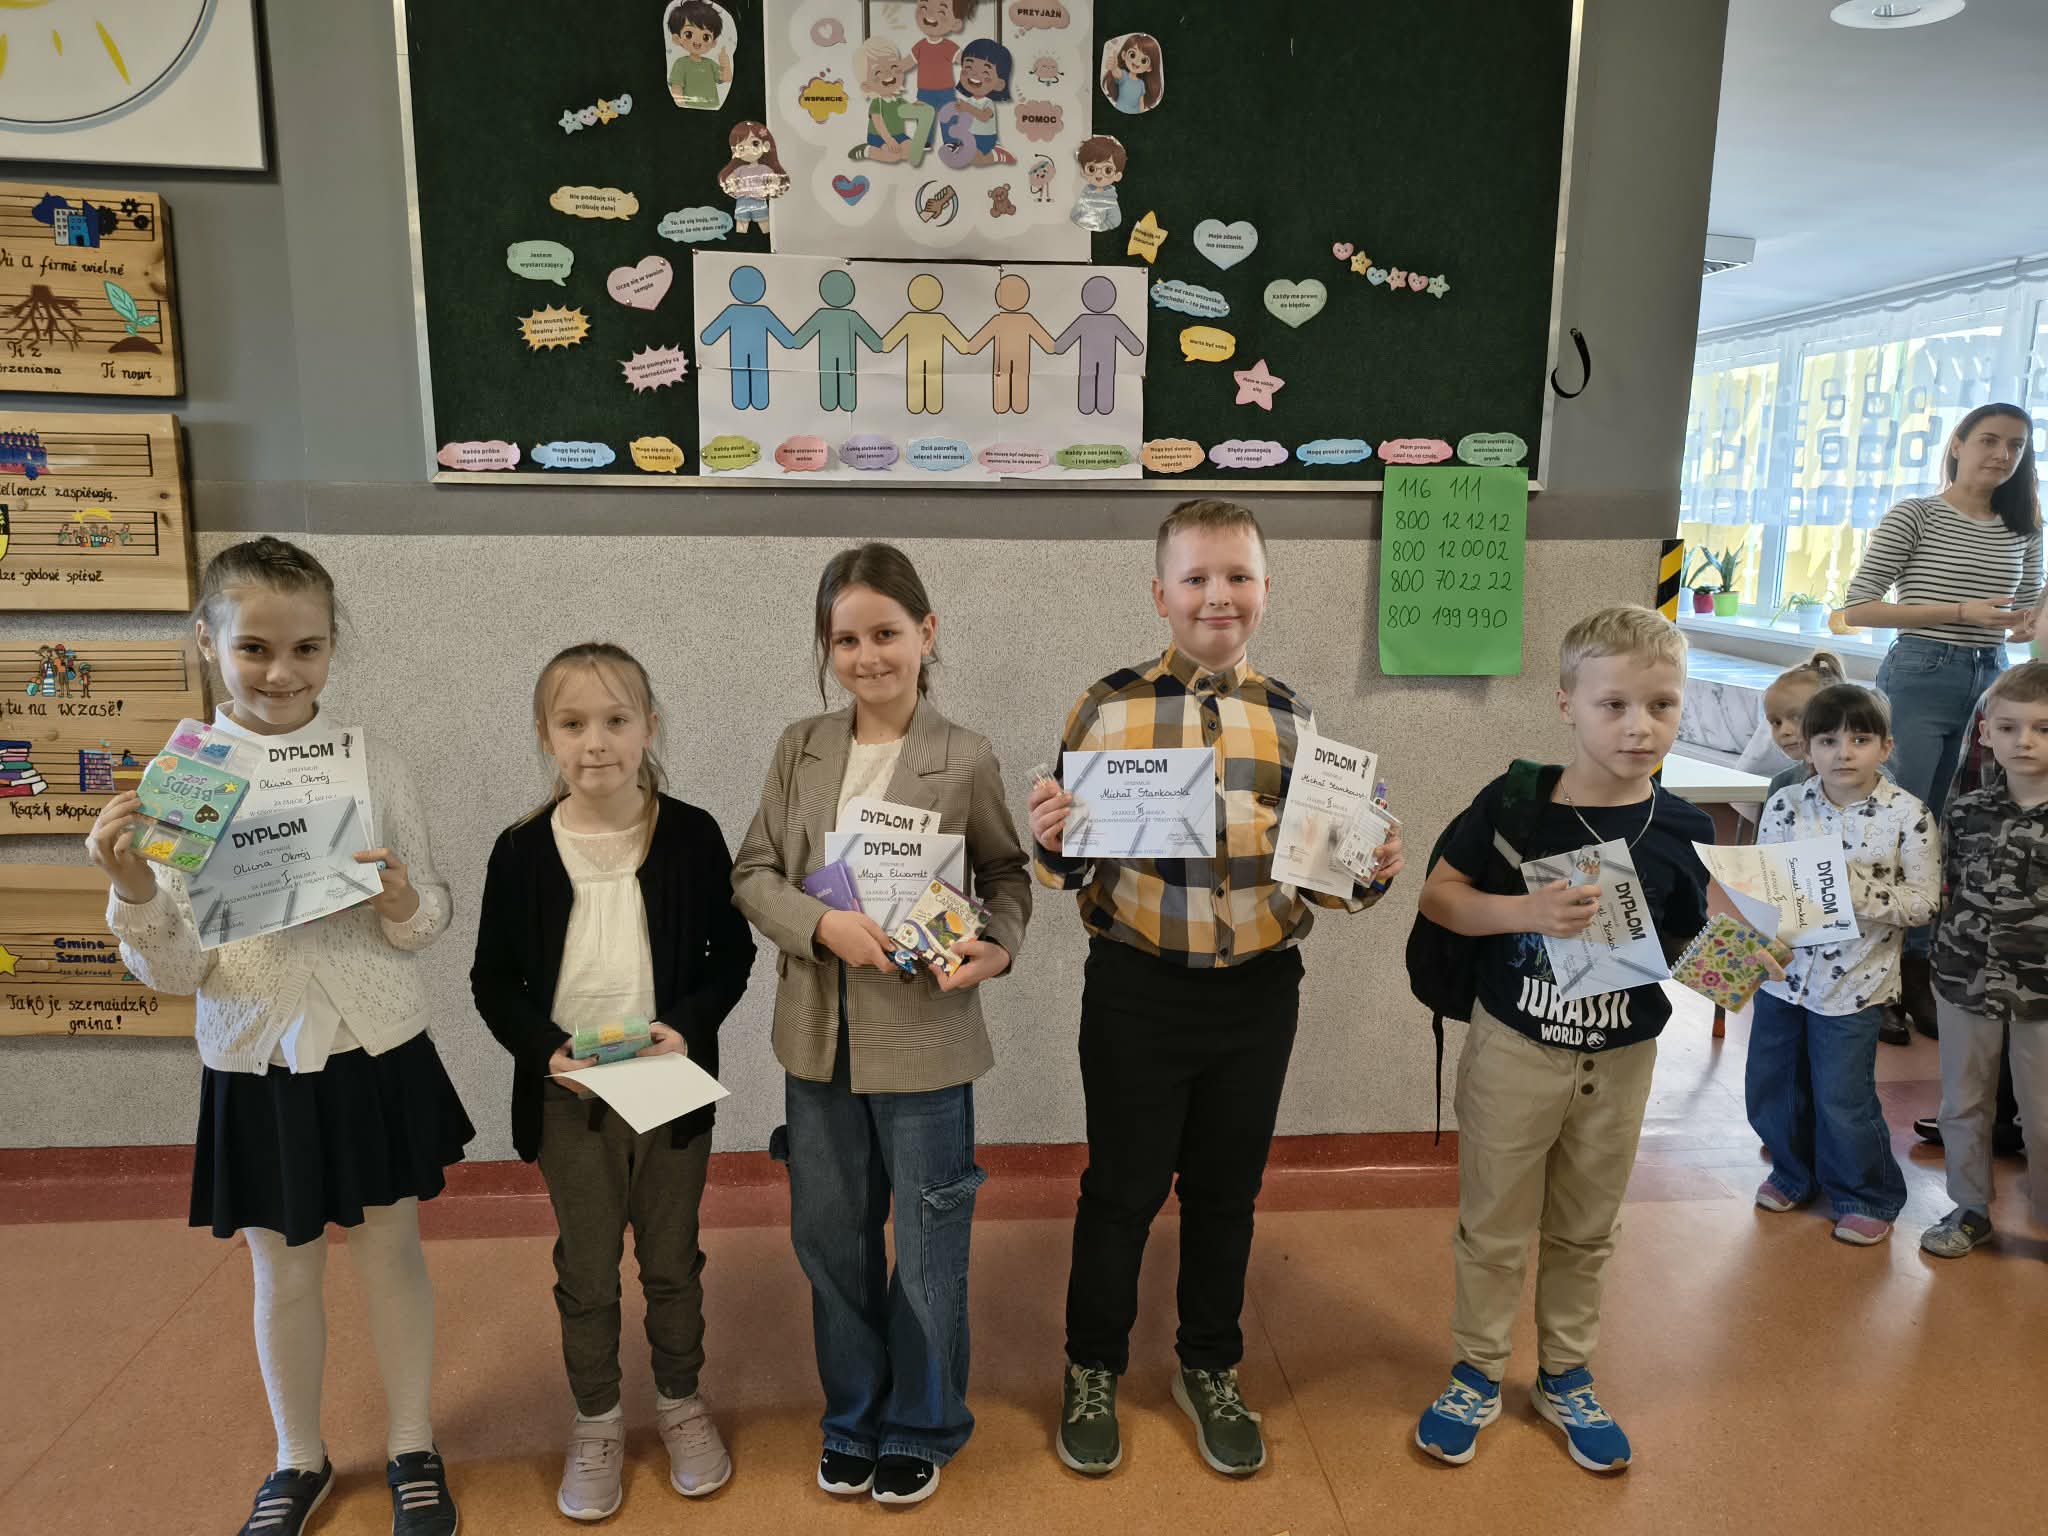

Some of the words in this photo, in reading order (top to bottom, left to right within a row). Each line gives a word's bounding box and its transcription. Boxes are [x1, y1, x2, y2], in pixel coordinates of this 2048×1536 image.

[1022, 115, 1057, 124] POMOC
[1396, 477, 1433, 498] 116
[1448, 474, 1482, 504] 111
[1394, 510, 1431, 531] 800
[1392, 539, 1426, 562] 800
[1390, 569, 1425, 593] 800
[1386, 605, 1422, 629] 800
[28, 703, 48, 716] na
[268, 743, 334, 763] DYPLOM
[1315, 747, 1357, 773] DYPLOM
[1107, 758, 1168, 775] DYPLOM
[161, 775, 213, 802] BEADS
[860, 808, 914, 831] DYPLOM
[231, 818, 308, 848] DYPLOM
[864, 841, 922, 857] DYPLOM
[1817, 859, 1839, 916] DYPLOM
[1614, 881, 1647, 941] DYPLOM
[54, 937, 105, 950] Gmina
[55, 951, 117, 964] Szemud
[1540, 1023, 1584, 1047] WORLD
